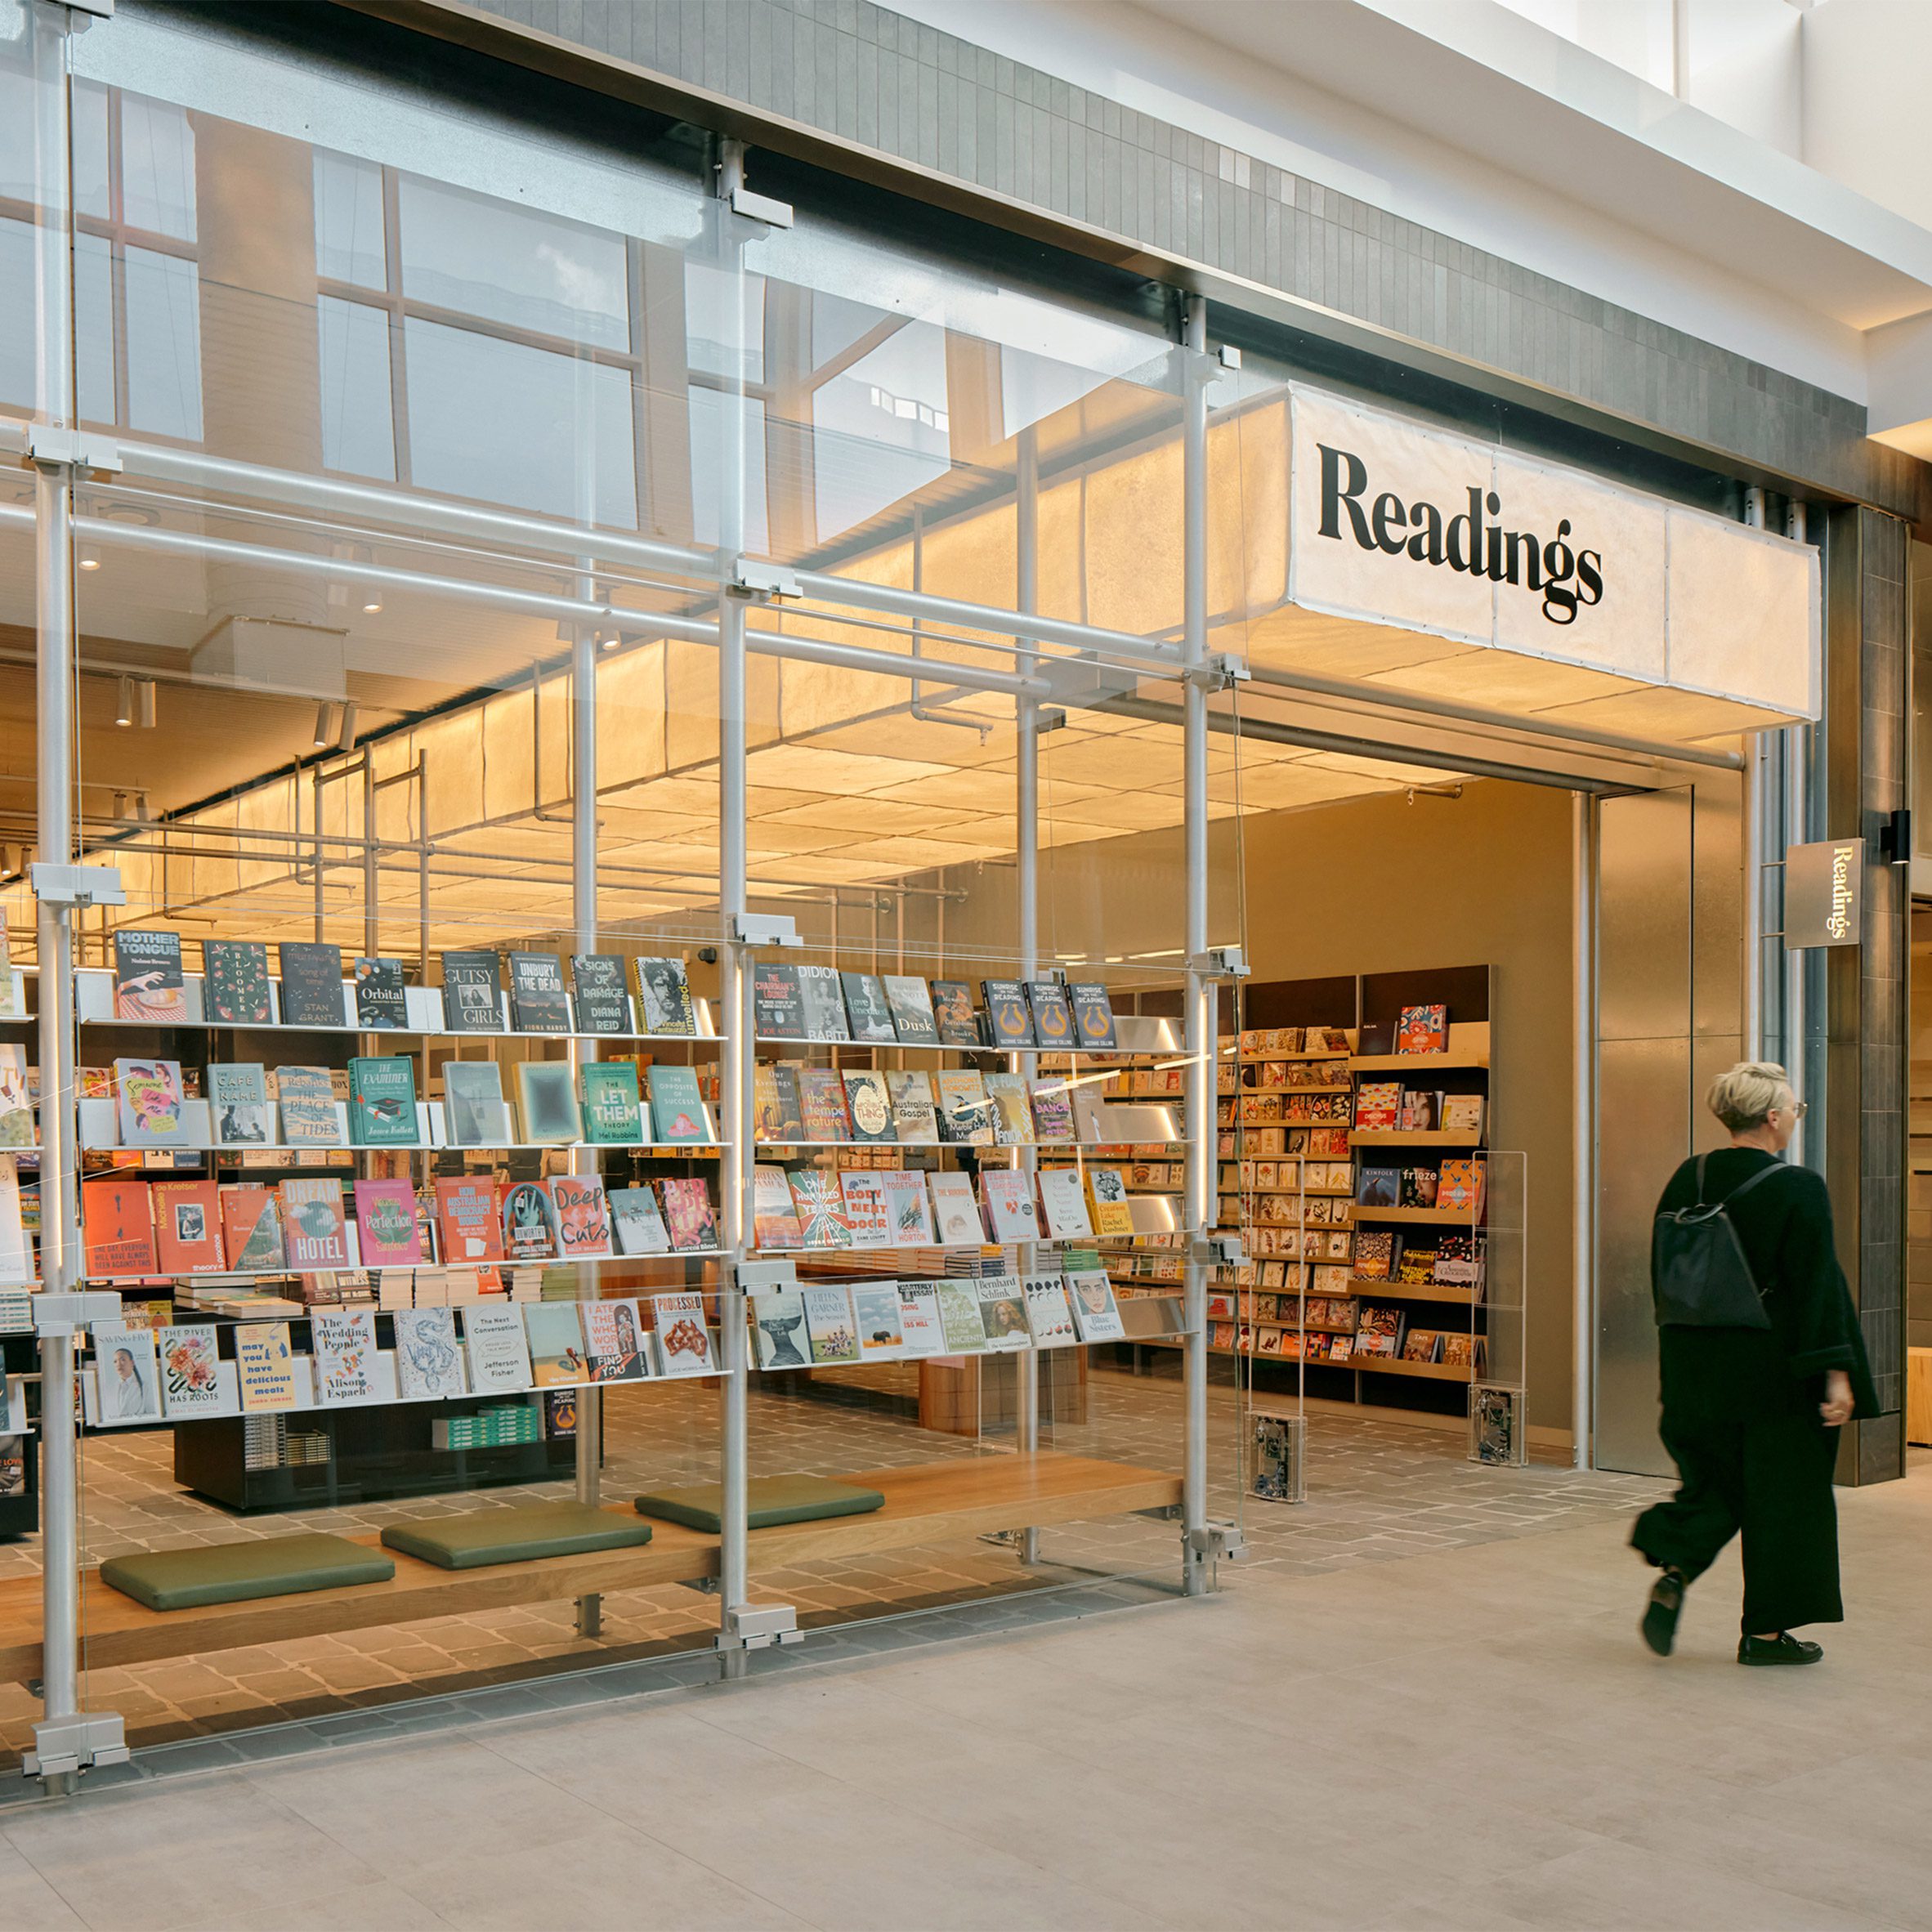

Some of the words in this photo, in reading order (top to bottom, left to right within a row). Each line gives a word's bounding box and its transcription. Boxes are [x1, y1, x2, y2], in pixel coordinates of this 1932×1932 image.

[1317, 442, 1603, 625] Readings
[1827, 846, 1854, 939] Readings
[118, 932, 179, 945] MOTHER
[119, 943, 179, 955] TONGUE
[520, 963, 555, 977] UNBURY
[585, 961, 615, 971] SIGNS
[445, 969, 494, 983] GUTSY
[767, 973, 779, 982] THE
[798, 966, 840, 980] DIDION
[235, 952, 246, 1013] BLOOMER
[517, 977, 534, 991] THE
[538, 978, 561, 991] DEAD
[595, 975, 608, 984] OF
[755, 982, 795, 991] CHAIRMAN'S
[992, 983, 1019, 991] SUNRISE
[362, 988, 403, 1000] Orbital
[583, 988, 624, 998] DAMAGE
[835, 1000, 843, 1012] &
[849, 997, 869, 1006] Love
[463, 1009, 503, 1024] GIRLS
[591, 1008, 621, 1017] DIANA
[597, 1021, 619, 1031] REID
[898, 1018, 932, 1031] Dusk
[807, 1029, 849, 1041] BABITZ
[378, 1063, 391, 1072] THE
[363, 1073, 409, 1085] EXAMINER
[942, 1076, 978, 1085] ANTHONY
[127, 1080, 163, 1096] Someone
[942, 1084, 981, 1092] HOROWITZ
[219, 1092, 258, 1102] NAME
[297, 1090, 317, 1099] THE
[600, 1089, 628, 1104] LET
[807, 1090, 825, 1104] the
[146, 1105, 162, 1114] Me
[289, 1100, 329, 1112] PLACE
[892, 1100, 935, 1109] Australian
[1035, 1103, 1069, 1113] DANCE
[593, 1106, 639, 1121] THEM
[810, 1106, 845, 1117] tempe
[856, 1107, 883, 1120] THING
[900, 1108, 930, 1119] Gospel
[311, 1113, 324, 1122] OF
[807, 1118, 843, 1127] rature
[301, 1124, 338, 1135] TIDES
[895, 1173, 912, 1181] TIME
[1402, 1169, 1438, 1181] frieze
[168, 1183, 198, 1191] Kretser
[287, 1180, 339, 1203] DREAM
[886, 1182, 923, 1190] TOGETHER
[554, 1187, 603, 1212] Deep
[797, 1191, 839, 1201] HUNDRED
[846, 1189, 882, 1200] BODY
[447, 1196, 490, 1207] AUSTRALIAN
[449, 1205, 490, 1217] DEMOCRACY
[803, 1204, 839, 1214] YEARS
[851, 1202, 888, 1214] NEXT
[365, 1214, 413, 1229] Perfection
[458, 1215, 485, 1225] WORKS
[847, 1219, 888, 1230] DOOR
[561, 1220, 610, 1245] Cuts
[897, 1233, 927, 1241] HORTON
[121, 1243, 150, 1252] EVERYONE
[297, 1237, 344, 1259] HOTEL
[95, 1254, 109, 1262] WILL
[127, 1251, 150, 1259] ALWAYS
[112, 1260, 136, 1268] AGAINST
[338, 1274, 370, 1286] WITNESS
[979, 1277, 1016, 1290] Bernhard
[897, 1283, 932, 1291] QUARTERLY
[813, 1293, 839, 1302] HELEN
[981, 1289, 1011, 1299] Schlink
[588, 1306, 592, 1314] I
[595, 1304, 614, 1313] ATE
[658, 1296, 701, 1312] PROCESSED
[811, 1303, 845, 1313] GARNER
[323, 1318, 342, 1328] The
[1091, 1315, 1110, 1325] Blue
[320, 1327, 368, 1339] Wedding
[474, 1324, 519, 1334] Conversation
[1088, 1323, 1117, 1333] Sisters
[242, 1343, 264, 1352] may
[324, 1339, 360, 1350] People
[601, 1346, 613, 1354] TO
[244, 1354, 262, 1363] you
[597, 1354, 623, 1366] FIND
[248, 1364, 272, 1373] have
[484, 1359, 519, 1370] Jefferson
[491, 1369, 514, 1377] Fisher
[602, 1365, 625, 1377] YOU
[246, 1375, 291, 1385] delicious
[328, 1378, 362, 1389] Alison
[255, 1386, 284, 1395] meals
[327, 1387, 366, 1399] Espach
[170, 1395, 186, 1403] HAS
[189, 1393, 218, 1402] ROOTS
